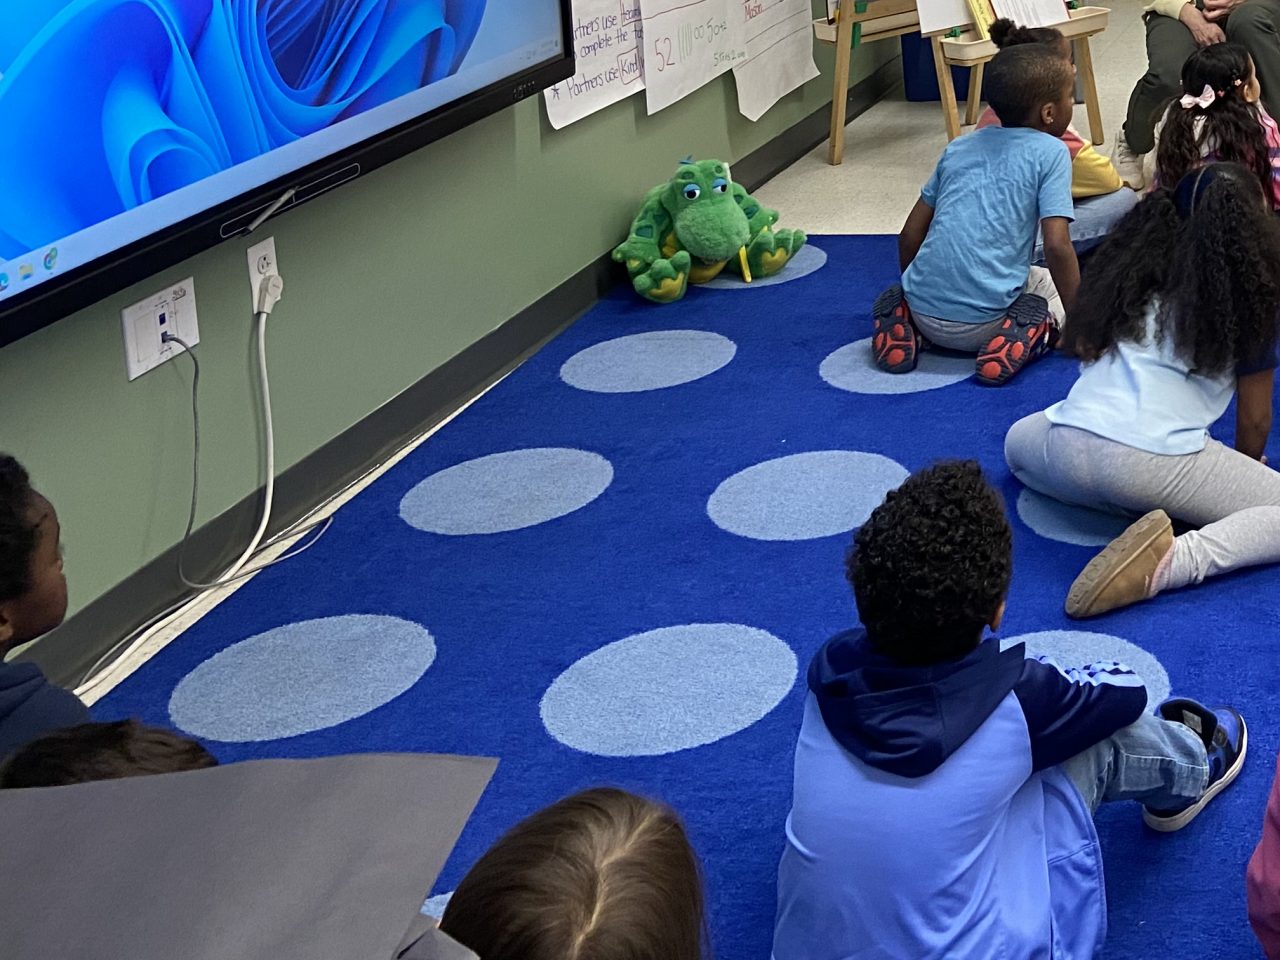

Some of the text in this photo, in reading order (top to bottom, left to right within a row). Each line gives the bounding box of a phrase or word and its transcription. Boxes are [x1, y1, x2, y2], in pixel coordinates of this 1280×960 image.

[602, 15, 617, 31] use
[580, 34, 613, 58] complete
[615, 27, 628, 45] the
[654, 38, 676, 72] 52
[566, 53, 638, 99] Partners use Kind
